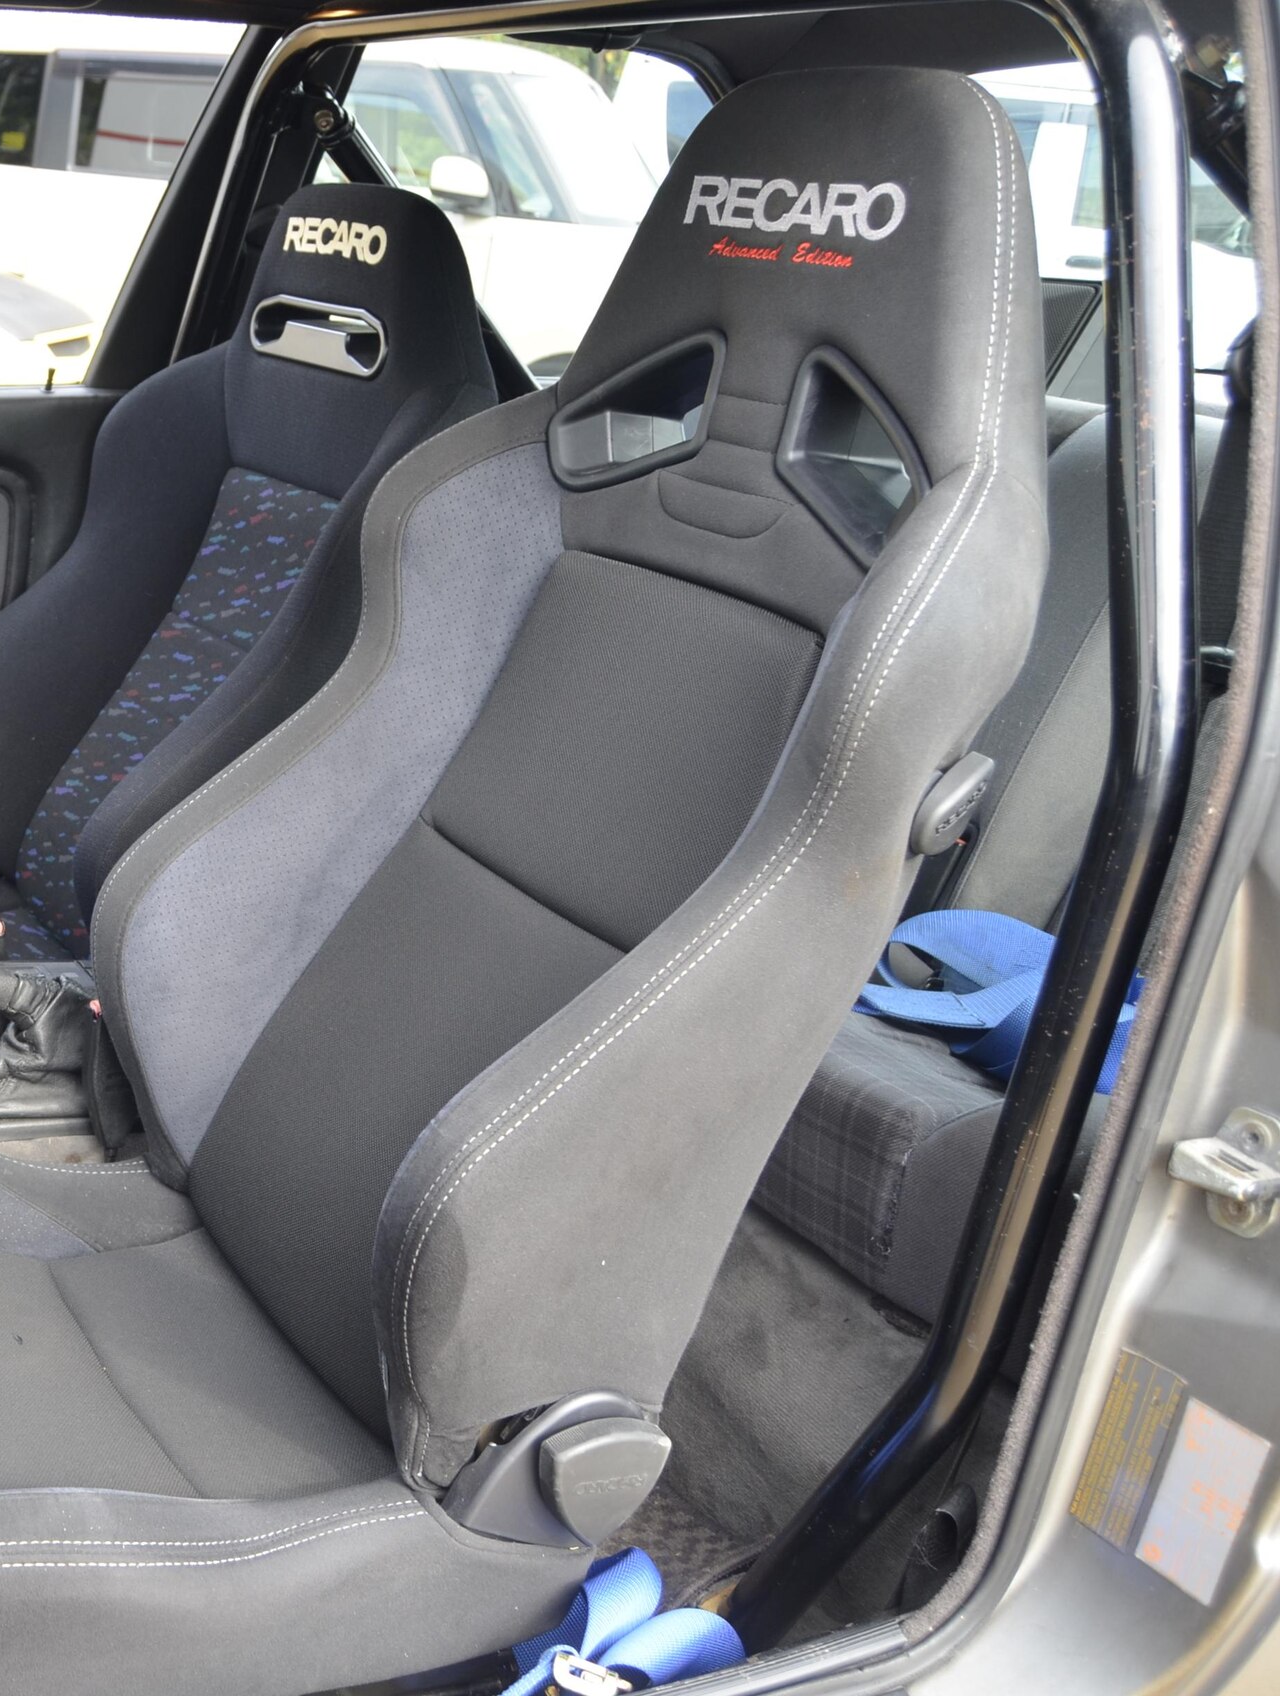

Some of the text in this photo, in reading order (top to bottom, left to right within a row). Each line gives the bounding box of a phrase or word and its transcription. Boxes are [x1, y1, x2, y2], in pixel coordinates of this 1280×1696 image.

[683, 175, 907, 241] RECARO
[282, 216, 388, 266] RECARO
[708, 235, 855, 268] Advanced Edition
